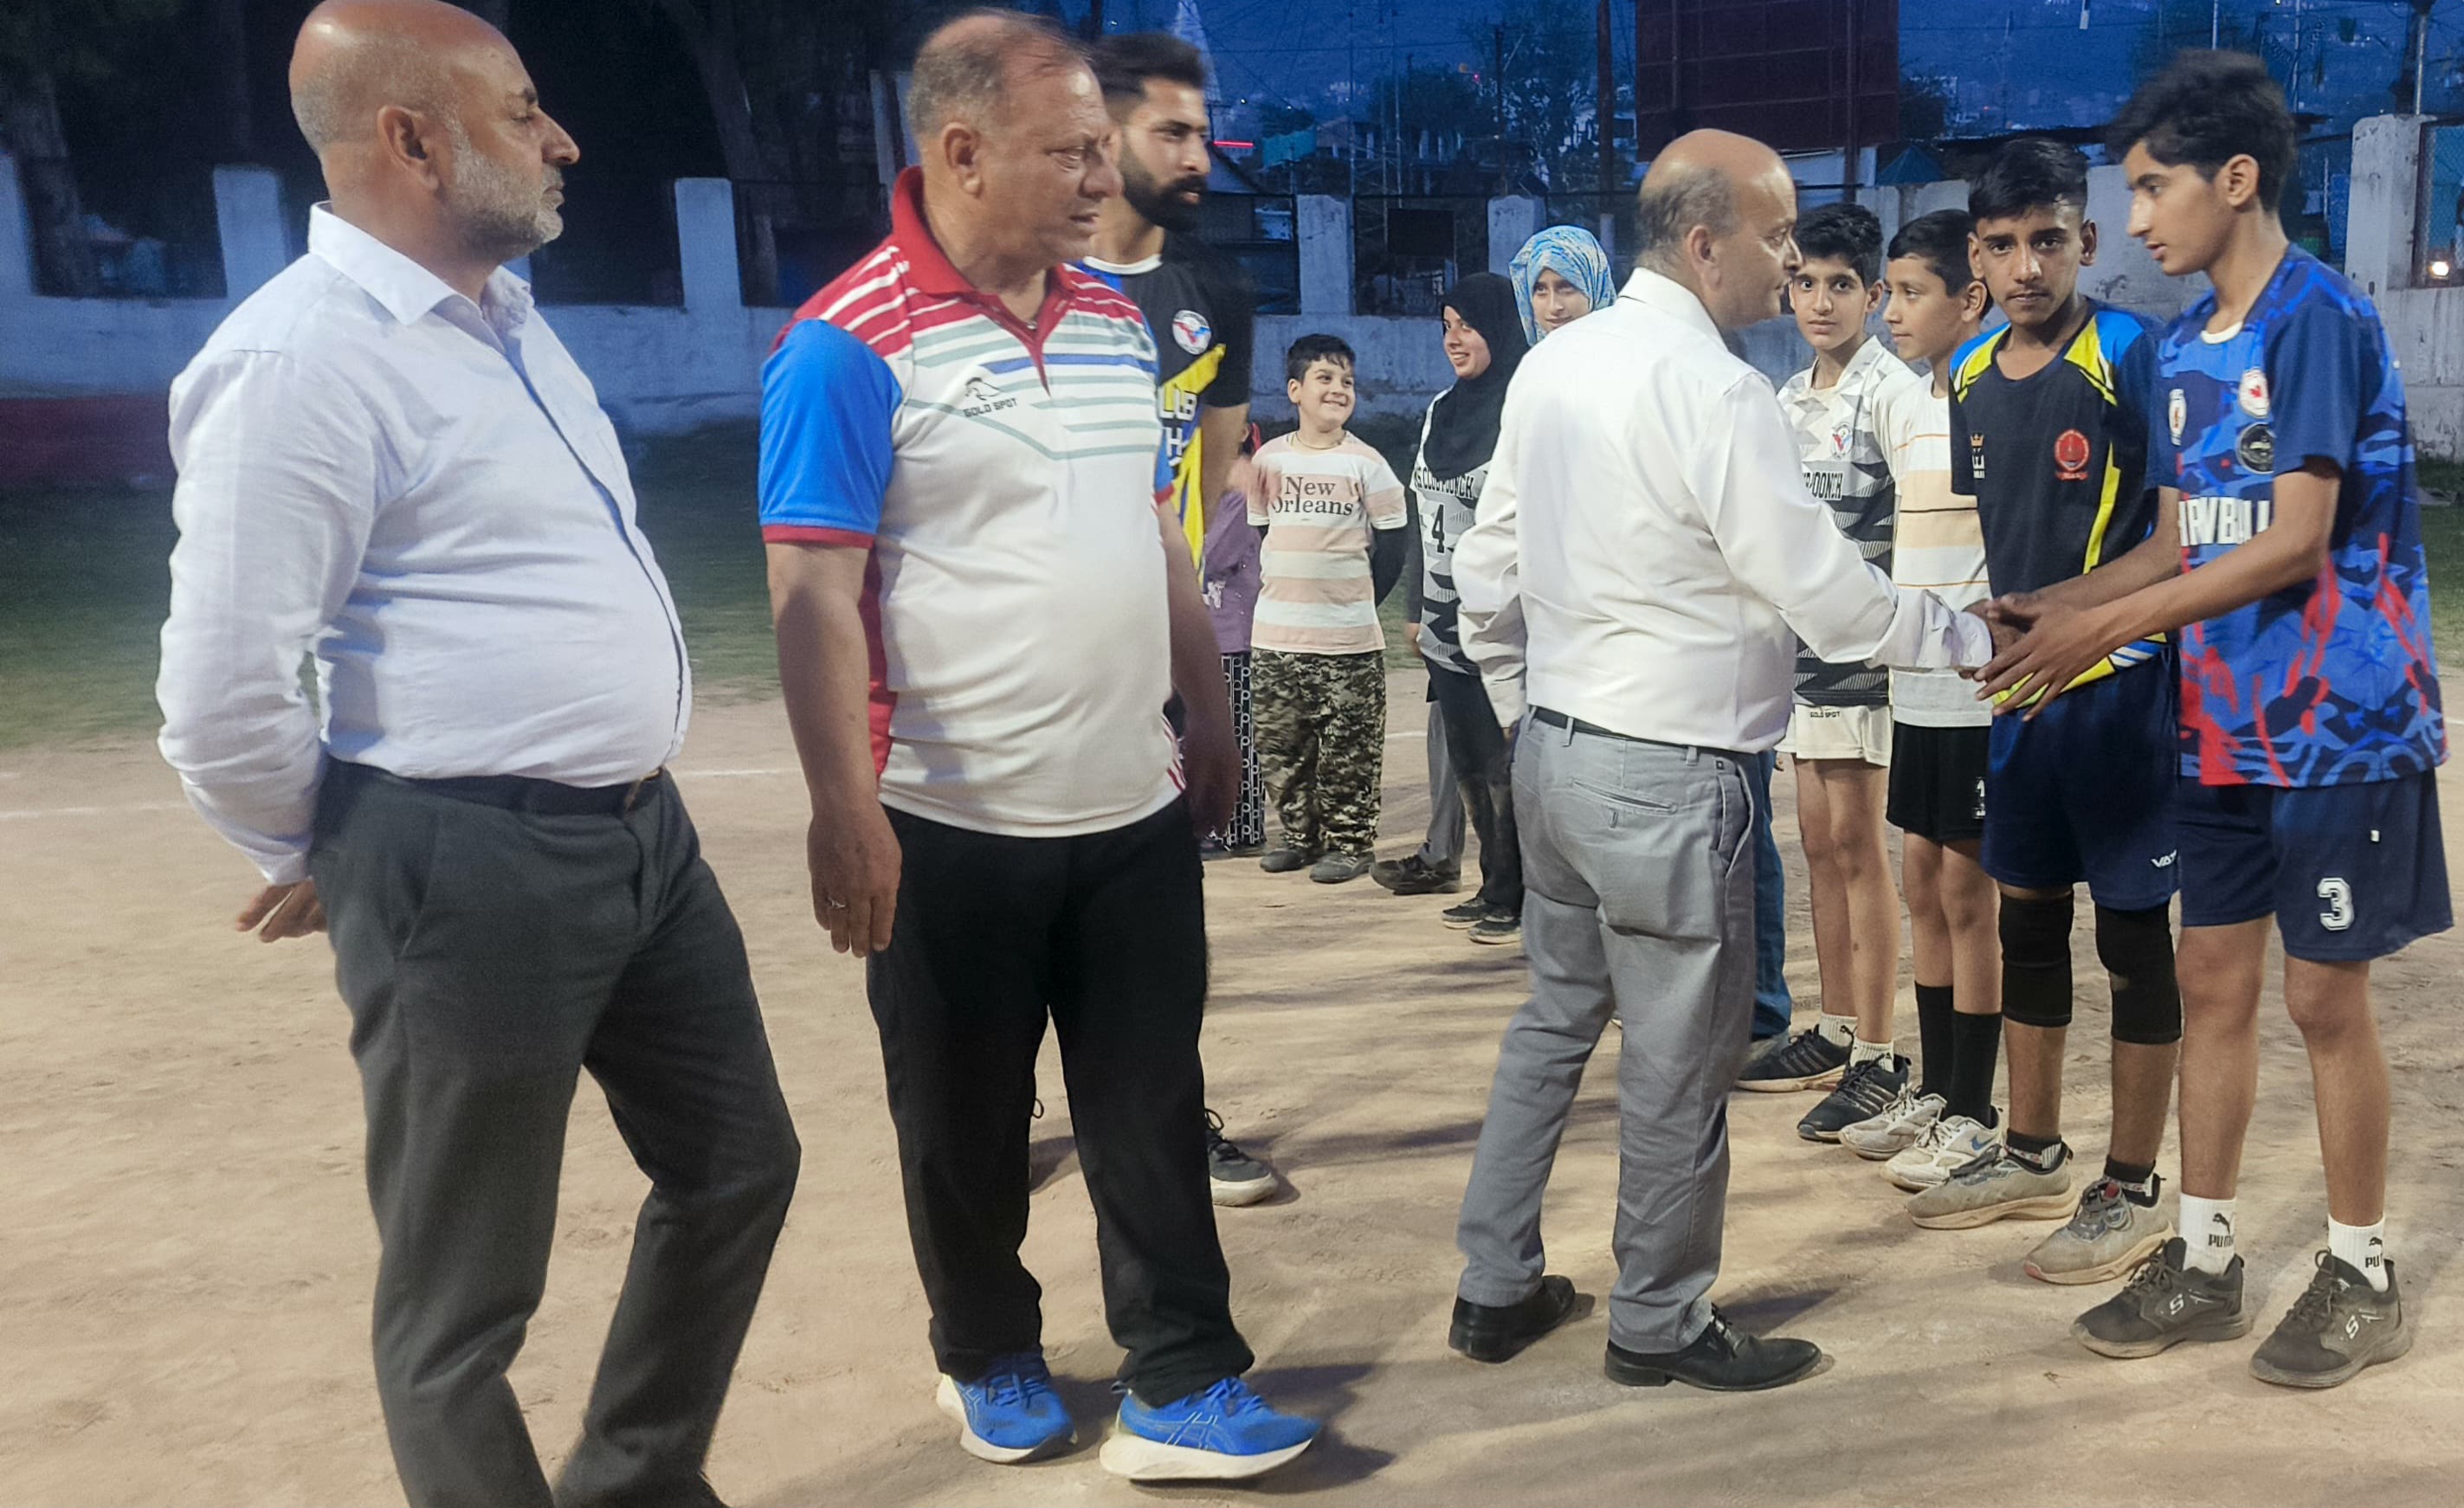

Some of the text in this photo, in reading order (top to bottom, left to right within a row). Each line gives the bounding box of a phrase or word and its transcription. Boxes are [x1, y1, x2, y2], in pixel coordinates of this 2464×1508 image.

[964, 397, 1018, 417] GOLD SPOT
[1284, 476, 1337, 496] New
[1271, 493, 1354, 516] Orleans
[1431, 504, 1445, 553] 4
[2316, 877, 2356, 931] 3
